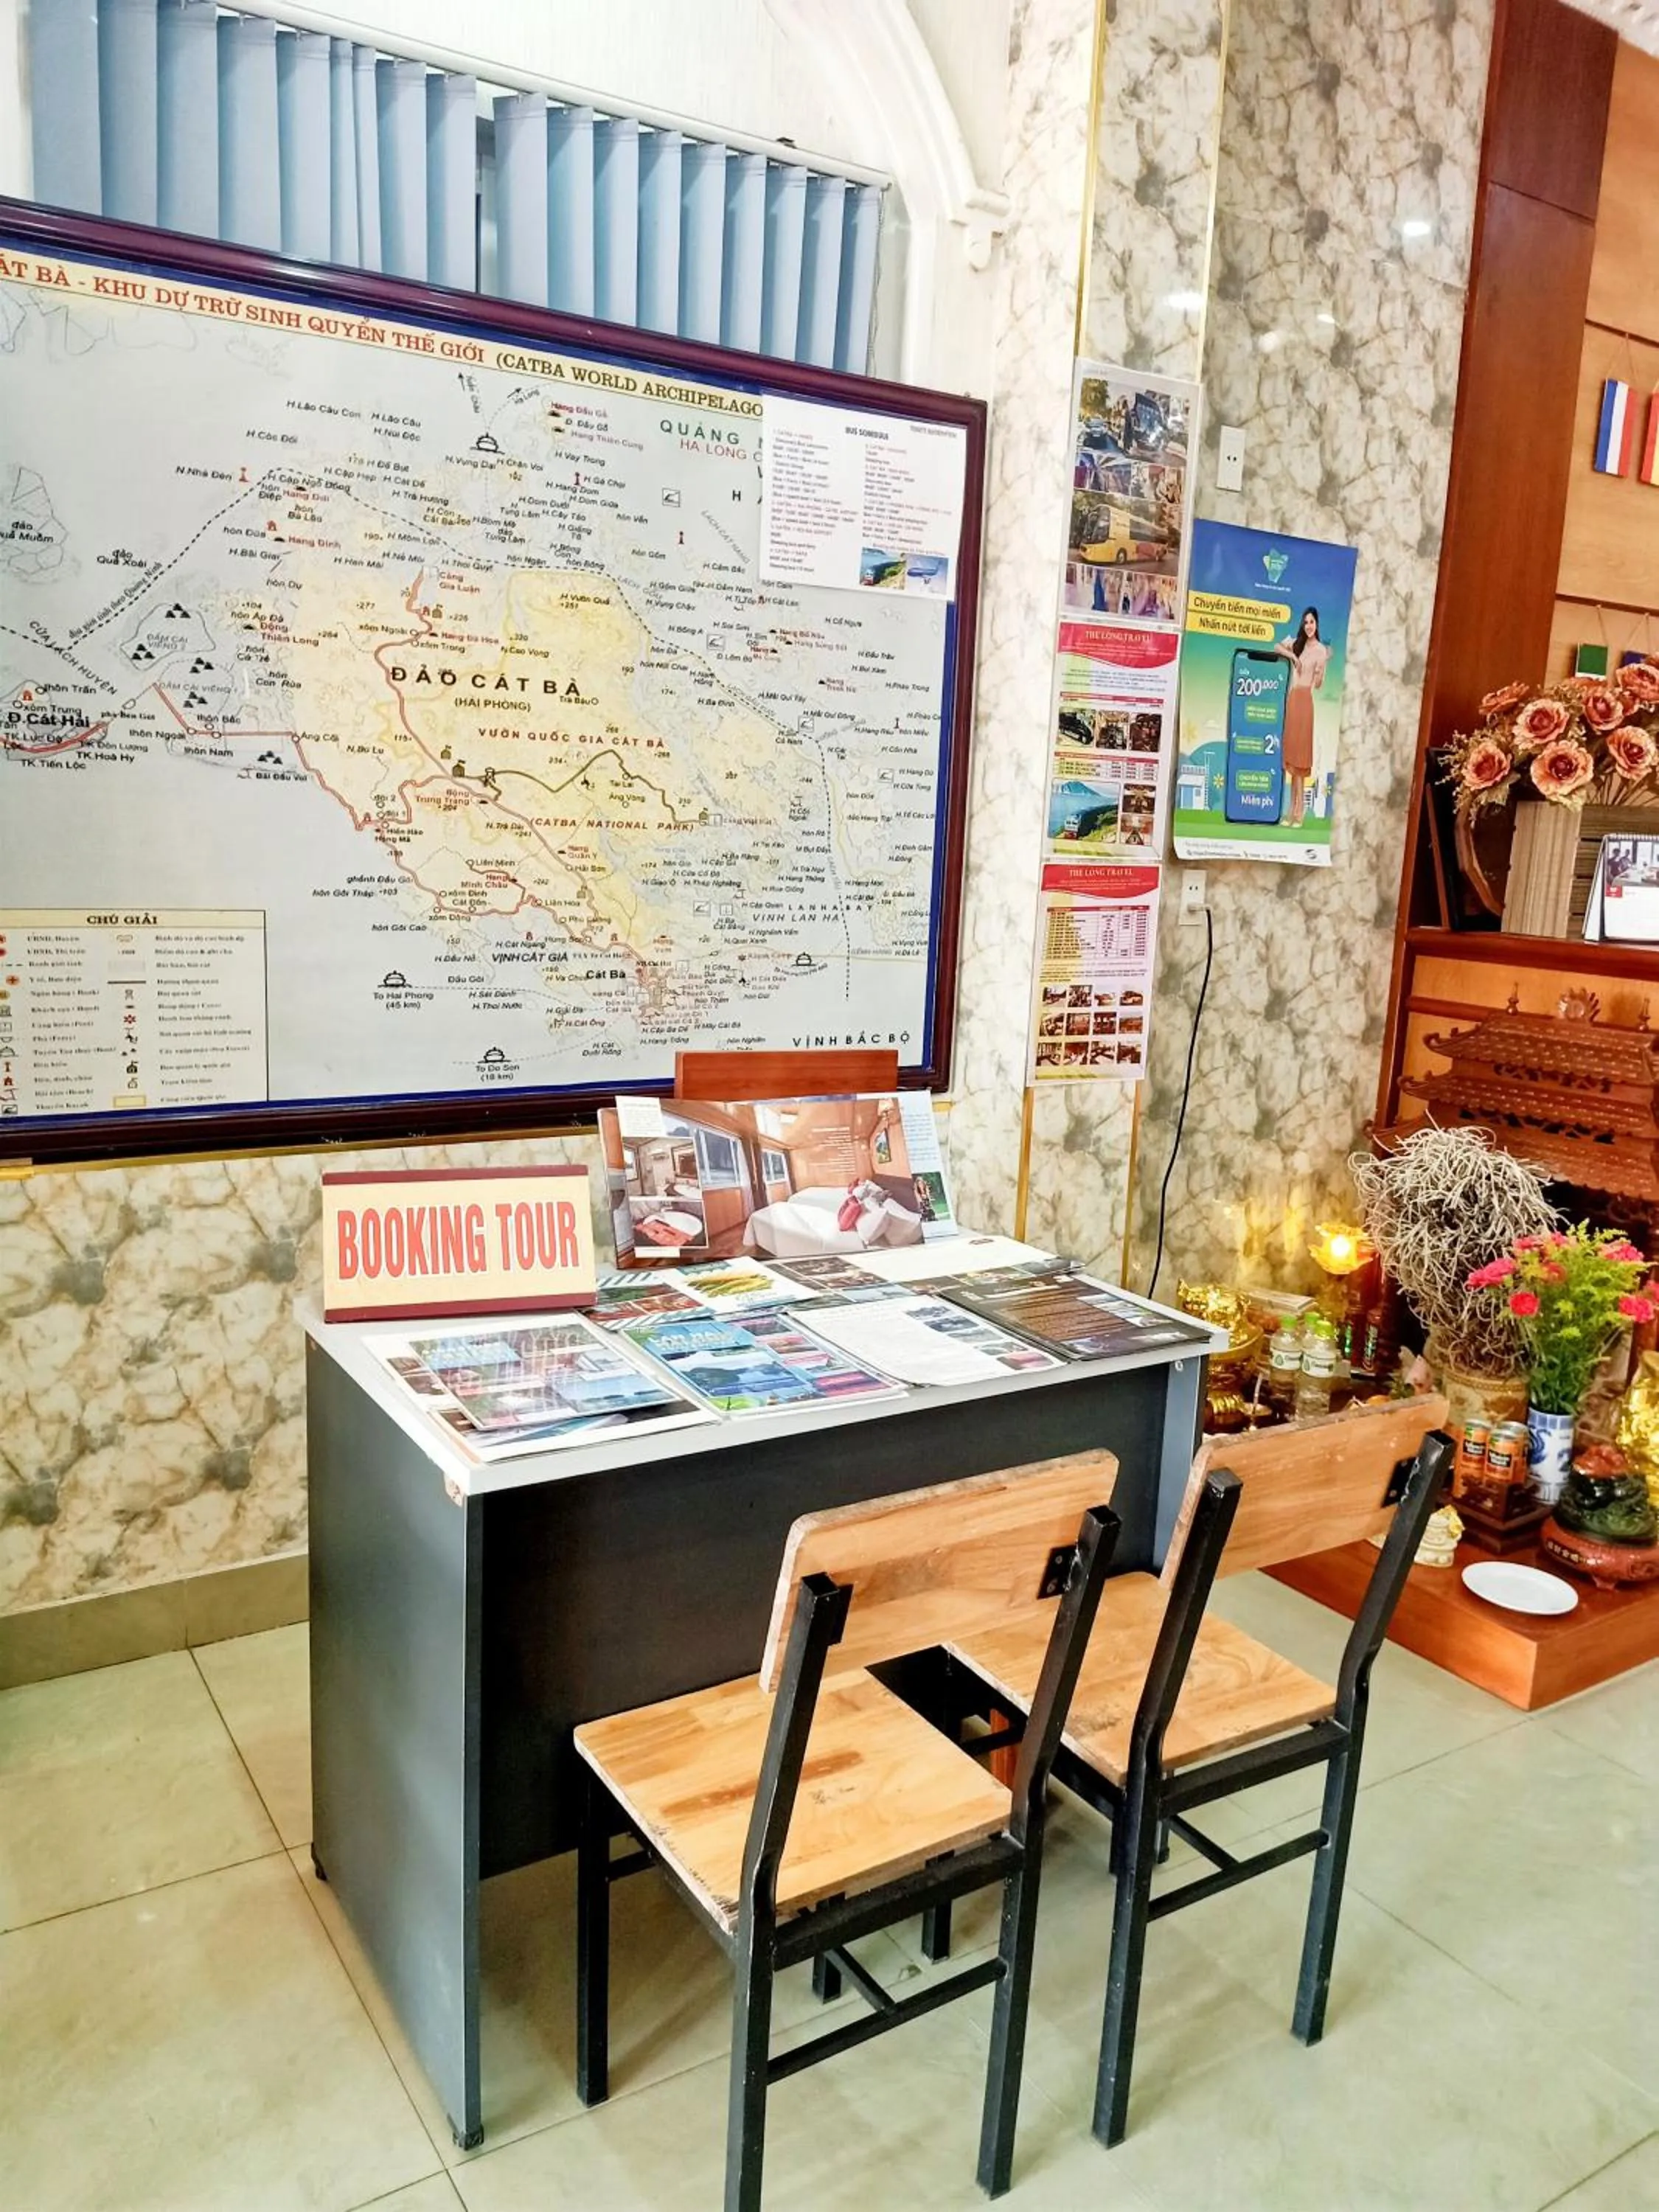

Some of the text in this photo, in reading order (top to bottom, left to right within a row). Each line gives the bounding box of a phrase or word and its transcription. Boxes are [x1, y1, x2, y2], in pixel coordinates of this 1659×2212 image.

[38, 265, 71, 286] BÀ
[94, 277, 146, 299] KHU
[156, 288, 189, 310] DỰ
[195, 295, 241, 316] TRỮ
[246, 304, 301, 328] SINH
[308, 316, 386, 344] QUYỂN
[392, 333, 434, 353] THẾ
[440, 345, 484, 362] GIỚI
[571, 366, 637, 392] WORLD
[642, 381, 763, 417] ARCHIPELAGO
[706, 444, 747, 461] LONG
[1194, 597, 1226, 612] Chuyển
[392, 664, 580, 696] ĐẢO CÁT BÀ
[479, 727, 520, 740] VƯỜN
[528, 729, 569, 742] QUỐC
[580, 731, 604, 744] GIA
[647, 737, 664, 748] BÀ
[121, 754, 134, 763] Hy
[209, 748, 233, 757] Nam
[587, 819, 647, 830] NATIONAL
[586, 970, 626, 979] Cát Bà
[405, 992, 434, 1001] Phong
[403, 1001, 420, 1009] km)
[338, 1201, 580, 1280] BOOKING TOUR
